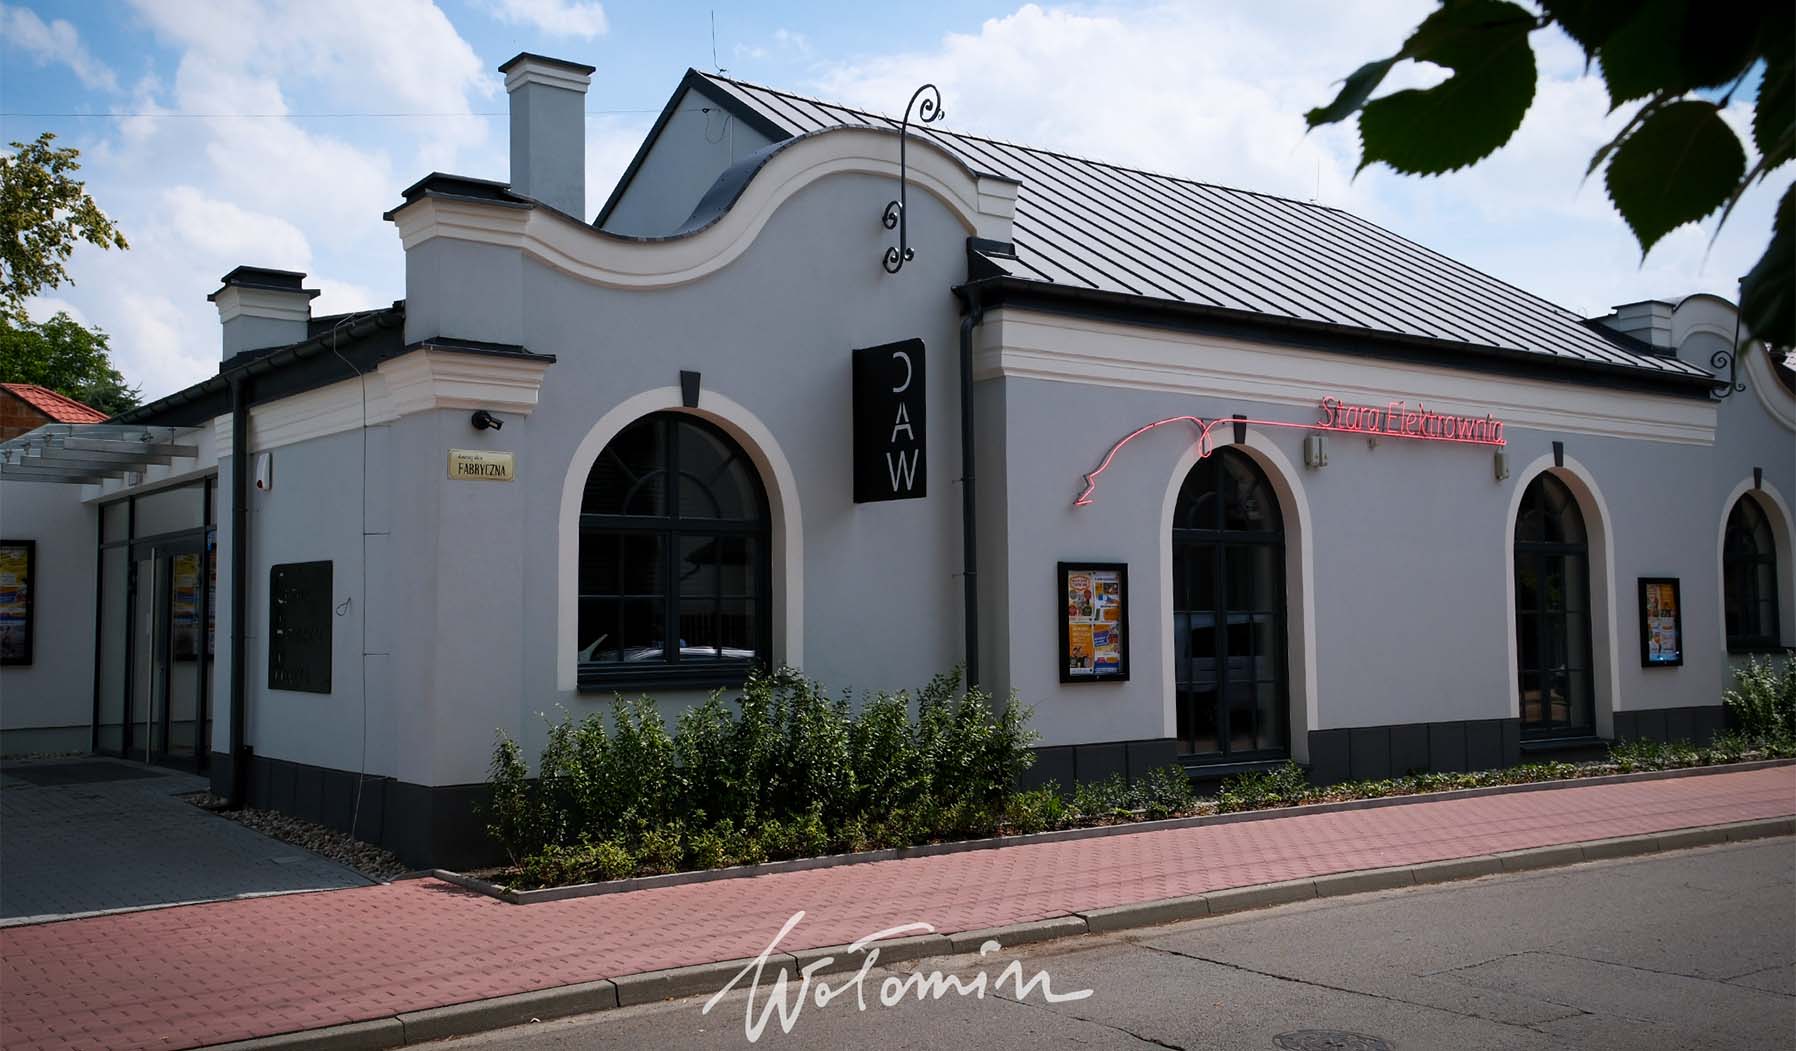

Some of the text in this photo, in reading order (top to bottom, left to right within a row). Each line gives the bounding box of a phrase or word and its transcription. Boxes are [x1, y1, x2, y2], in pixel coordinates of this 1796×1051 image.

[1318, 395, 1505, 442] Stara Elektrownia
[457, 462, 506, 476] FABRYCZNA
